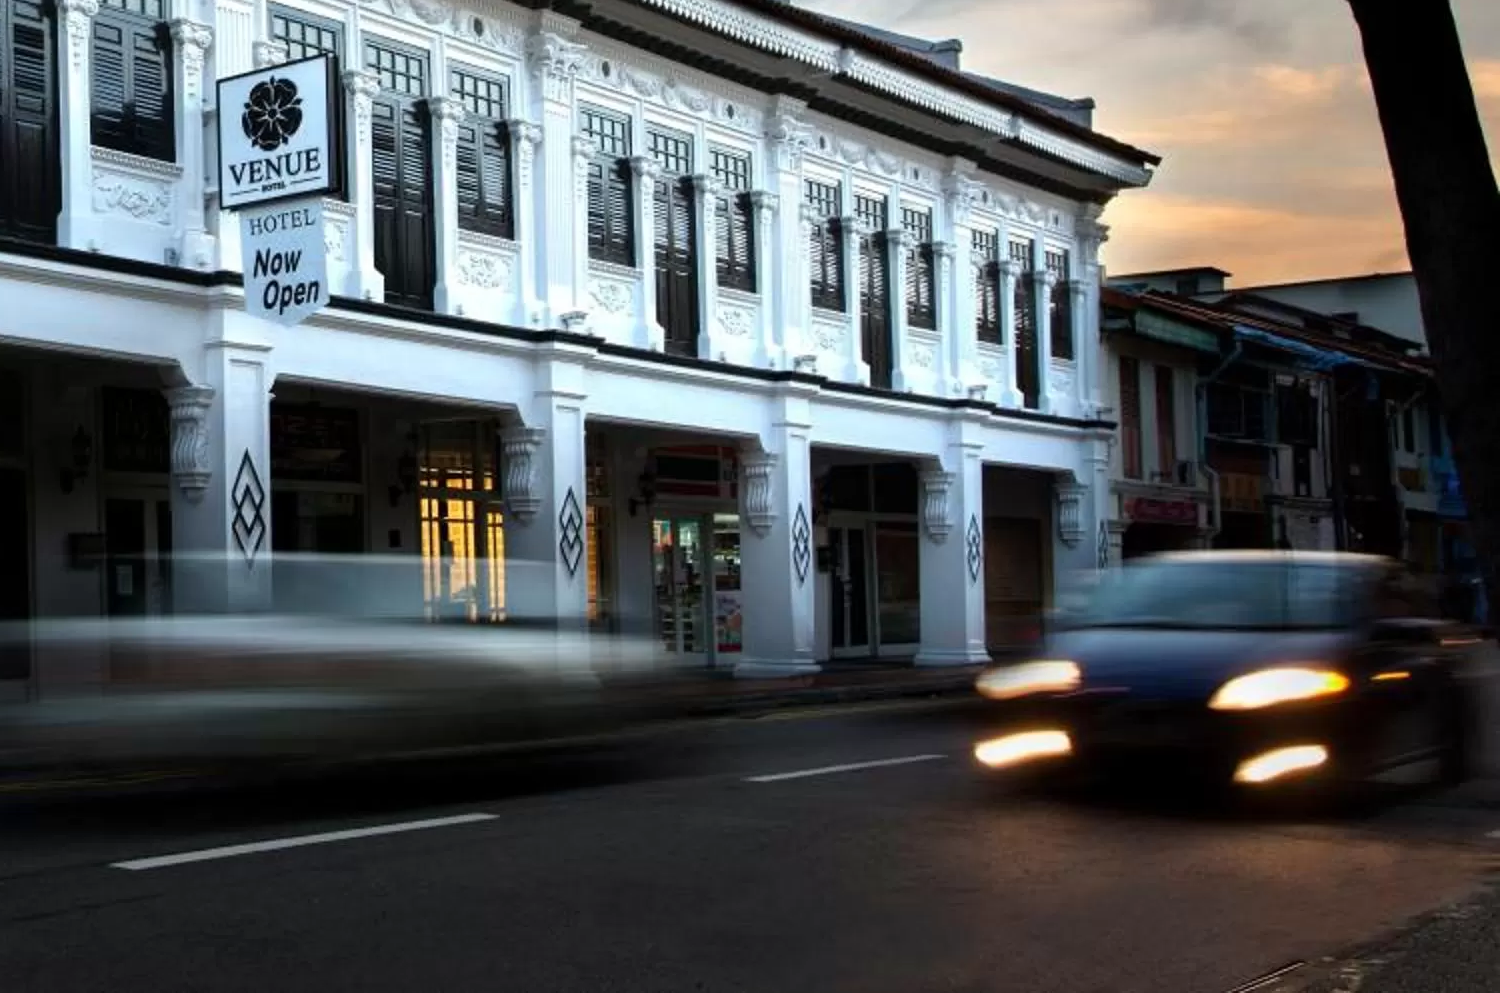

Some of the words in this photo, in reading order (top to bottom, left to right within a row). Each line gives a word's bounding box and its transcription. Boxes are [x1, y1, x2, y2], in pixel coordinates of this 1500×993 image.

[228, 147, 321, 186] VENUE
[249, 209, 315, 236] HOTEL
[253, 247, 302, 278] Now
[263, 279, 319, 315] Open
